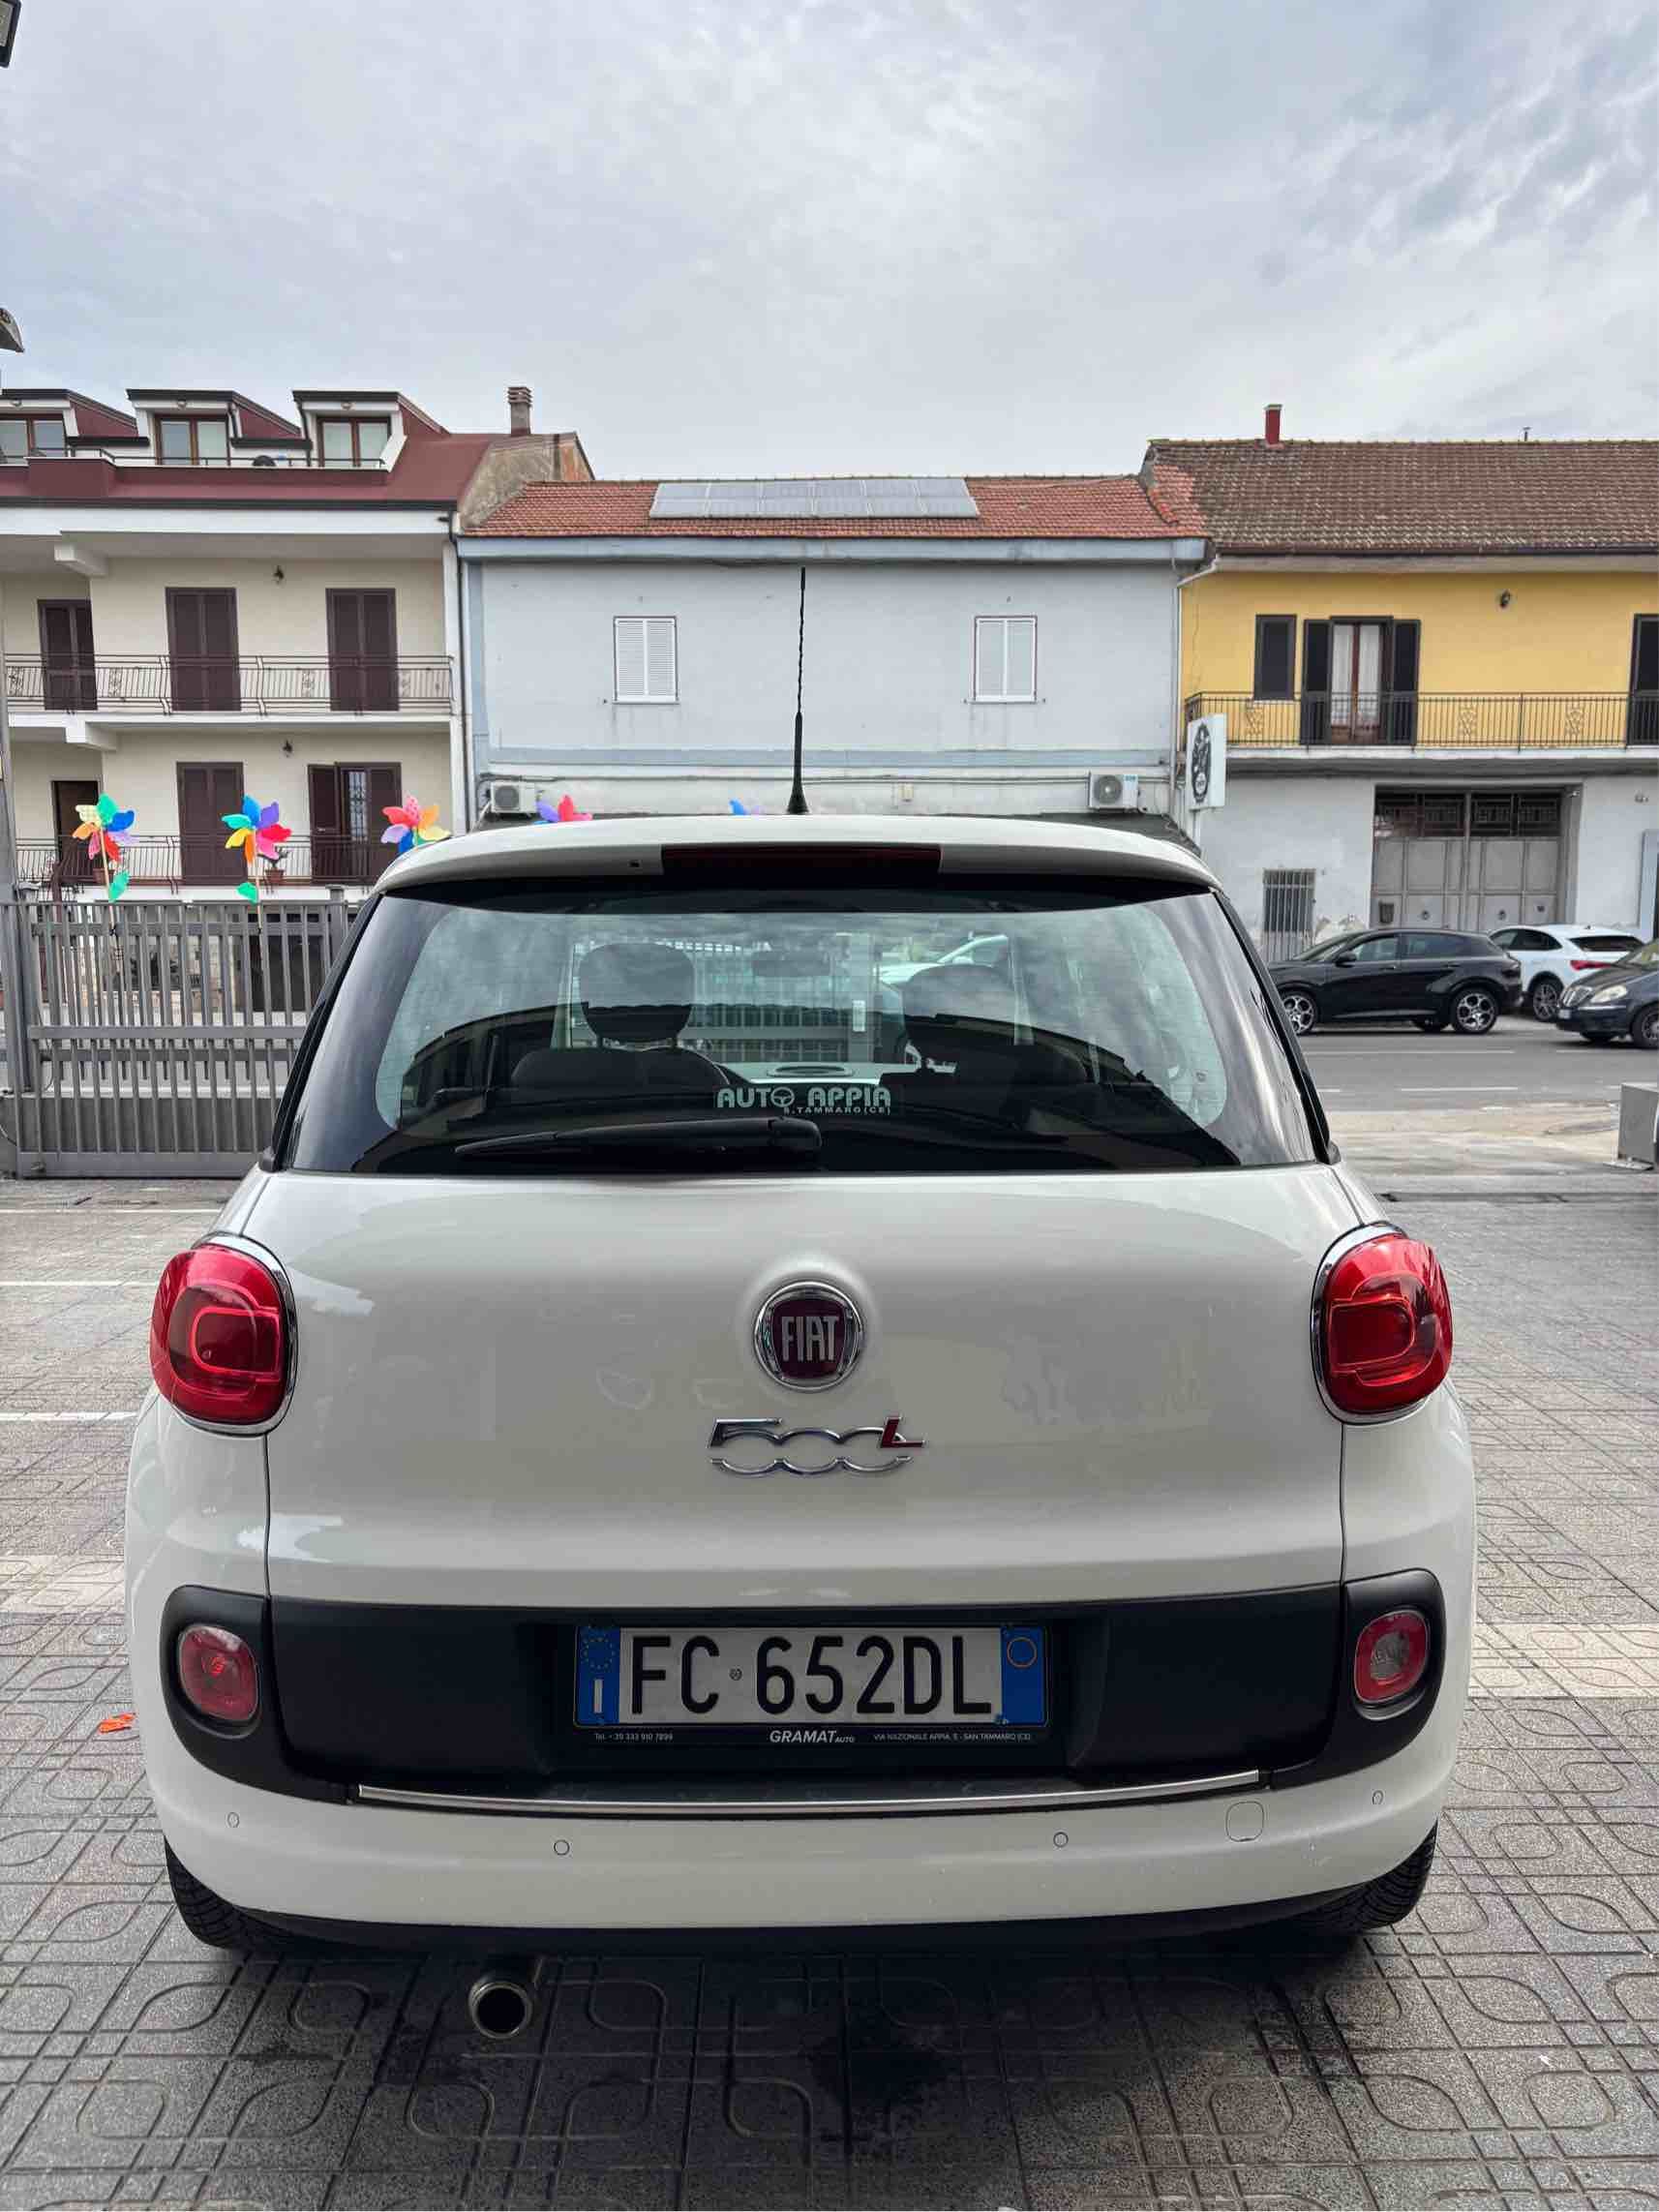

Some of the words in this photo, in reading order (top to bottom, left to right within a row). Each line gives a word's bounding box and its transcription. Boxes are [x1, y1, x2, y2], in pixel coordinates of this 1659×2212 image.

[716, 1086, 796, 1108] AUTO
[806, 1086, 891, 1108] APPIA
[781, 1315, 840, 1362] FIAT
[631, 1635, 720, 1714] FC
[756, 1635, 992, 1714] 652DL
[769, 1730, 837, 1743] GRAMAT
